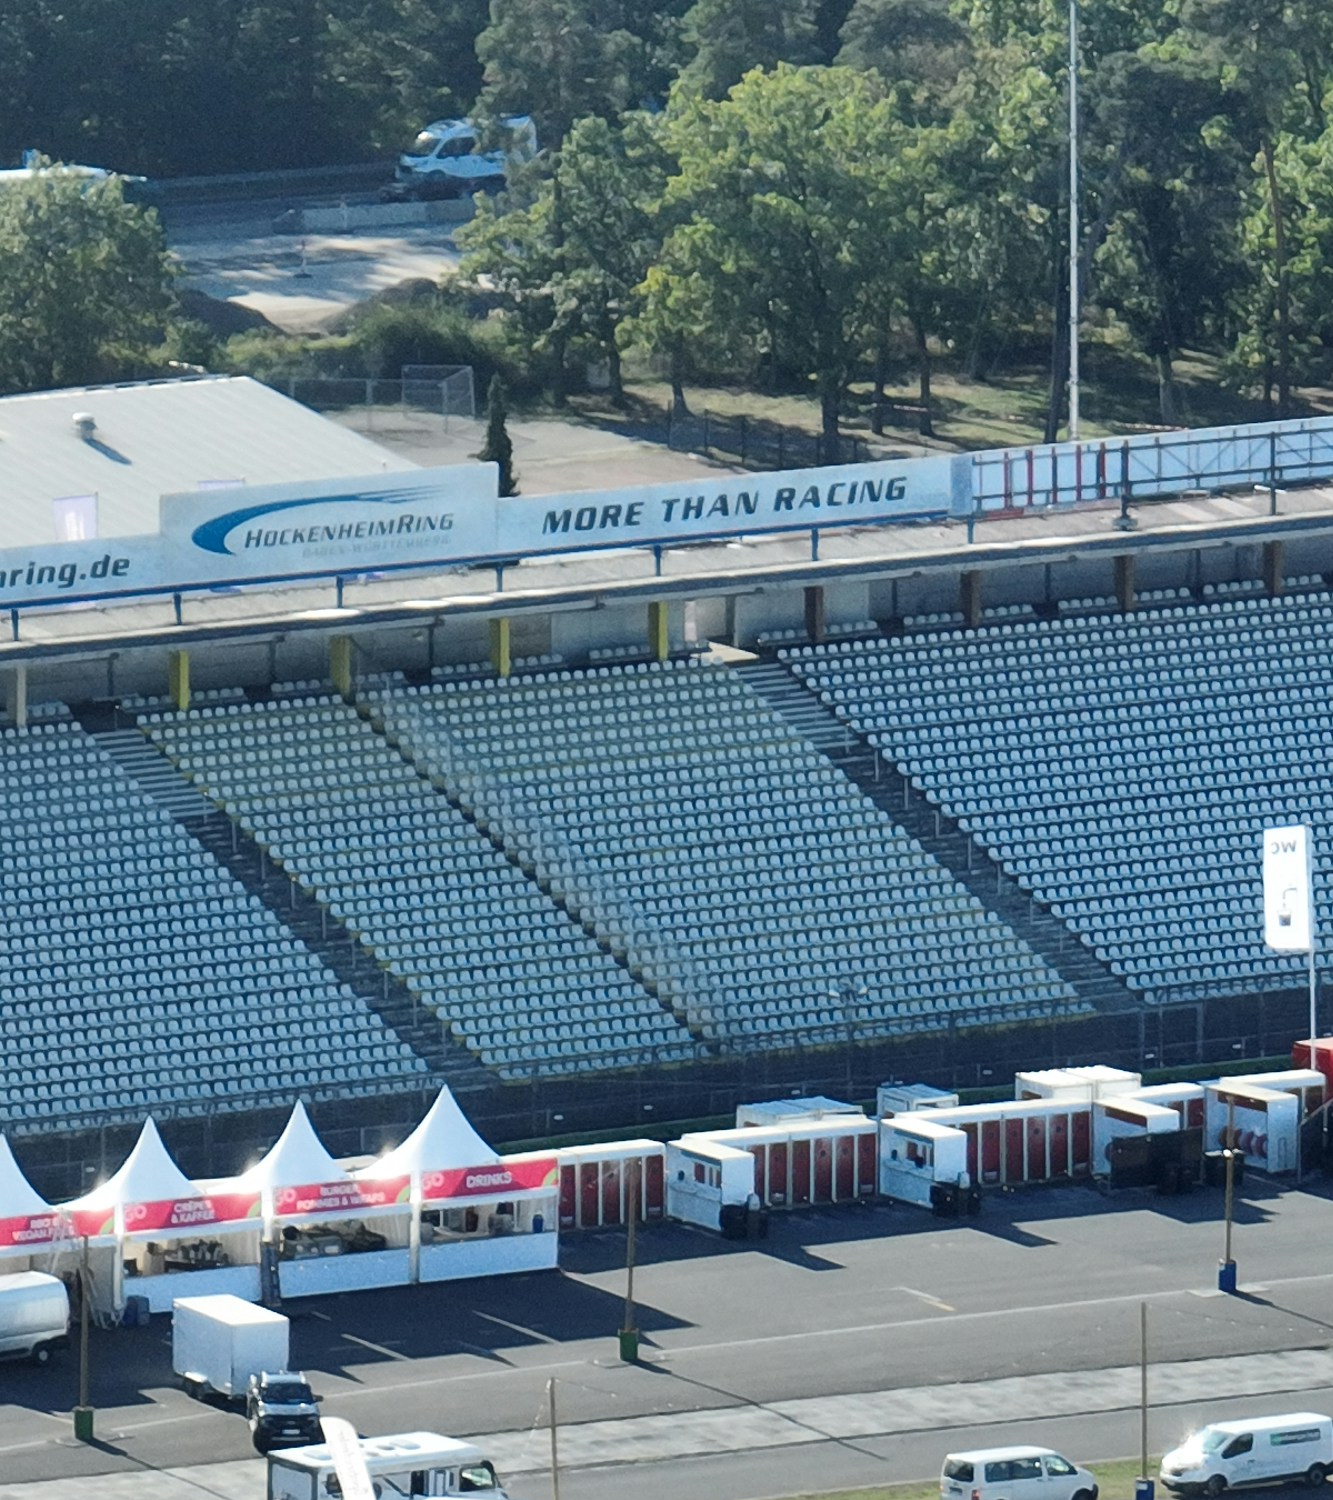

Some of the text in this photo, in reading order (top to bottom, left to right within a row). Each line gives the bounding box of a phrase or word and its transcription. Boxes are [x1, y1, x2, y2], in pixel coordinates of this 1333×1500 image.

[542, 476, 908, 535] MORE THAN RACING
[466, 1171, 512, 1188] DRINKS
